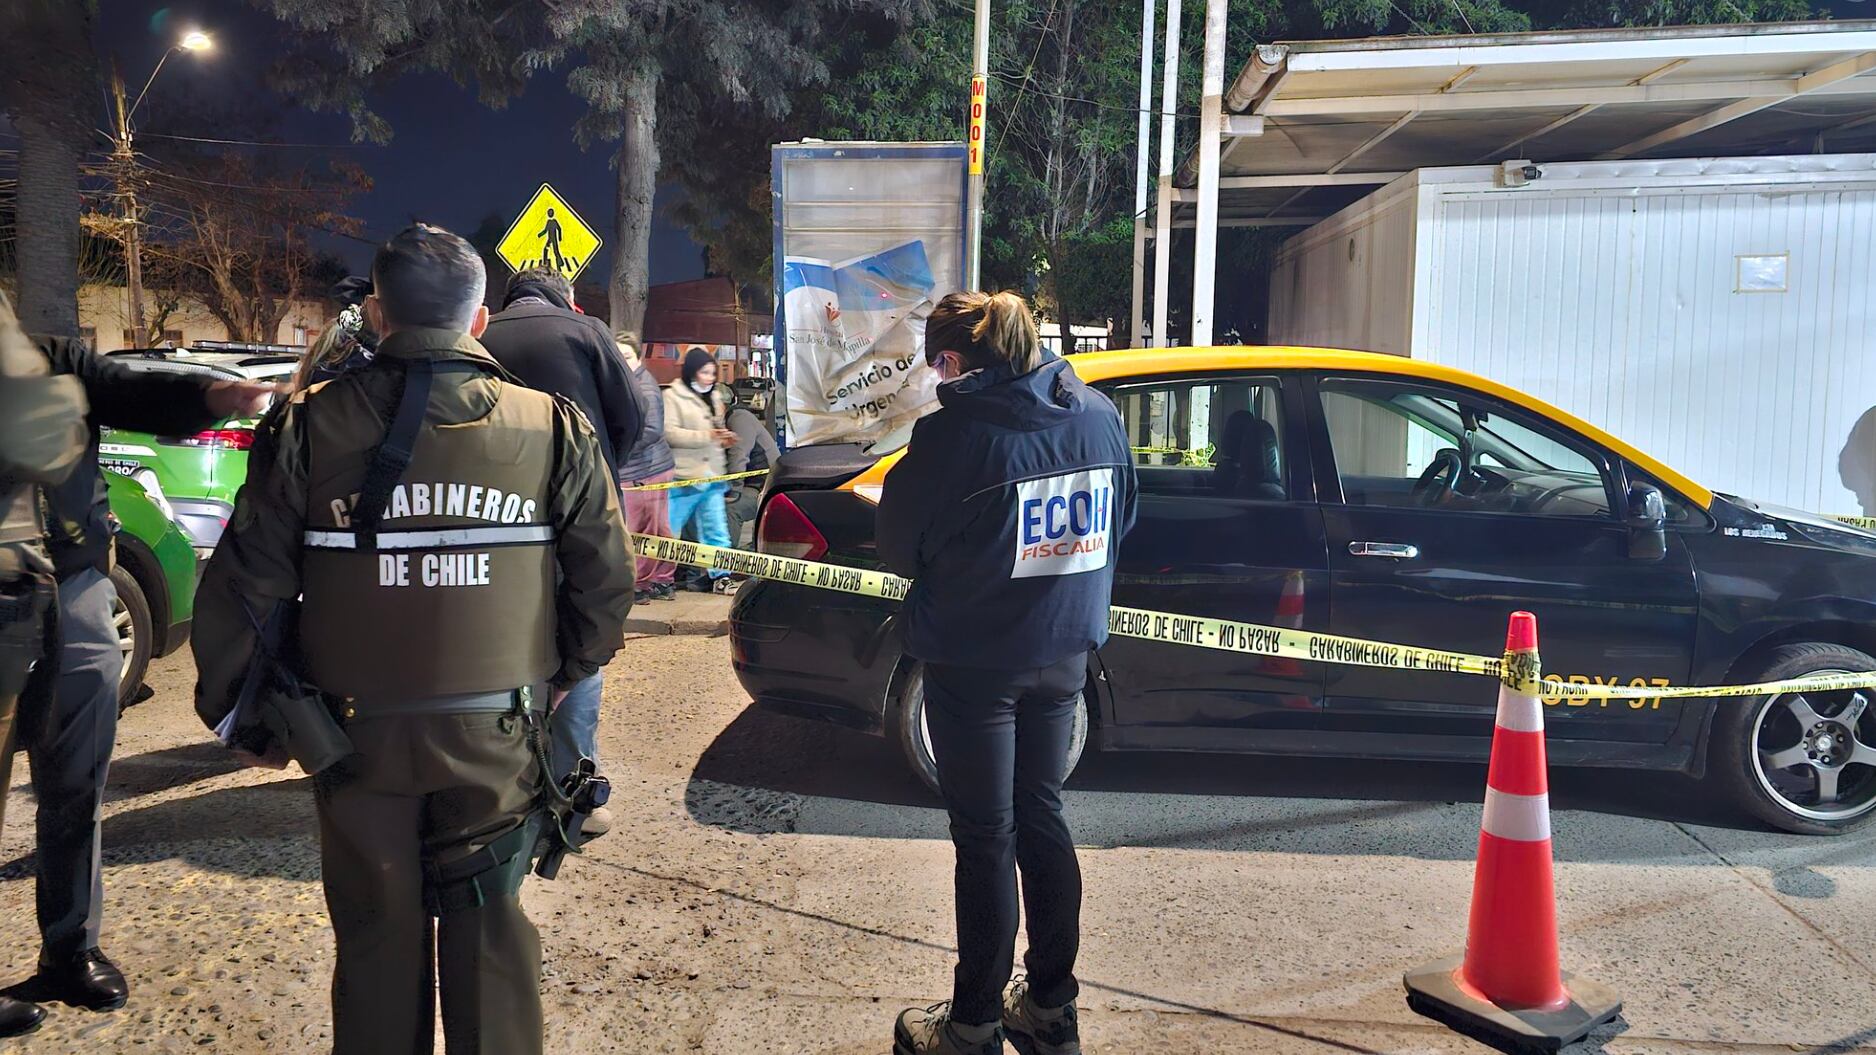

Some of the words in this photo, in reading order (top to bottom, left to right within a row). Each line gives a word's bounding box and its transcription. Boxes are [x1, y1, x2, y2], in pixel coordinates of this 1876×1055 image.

[970, 80, 985, 164] M001
[825, 365, 892, 405] Servicio
[330, 482, 537, 528] CABINEROS
[1023, 487, 1108, 546] ECOH
[379, 553, 410, 587] DE
[421, 553, 490, 587] CHILE
[1022, 537, 1104, 560] FISCALIA
